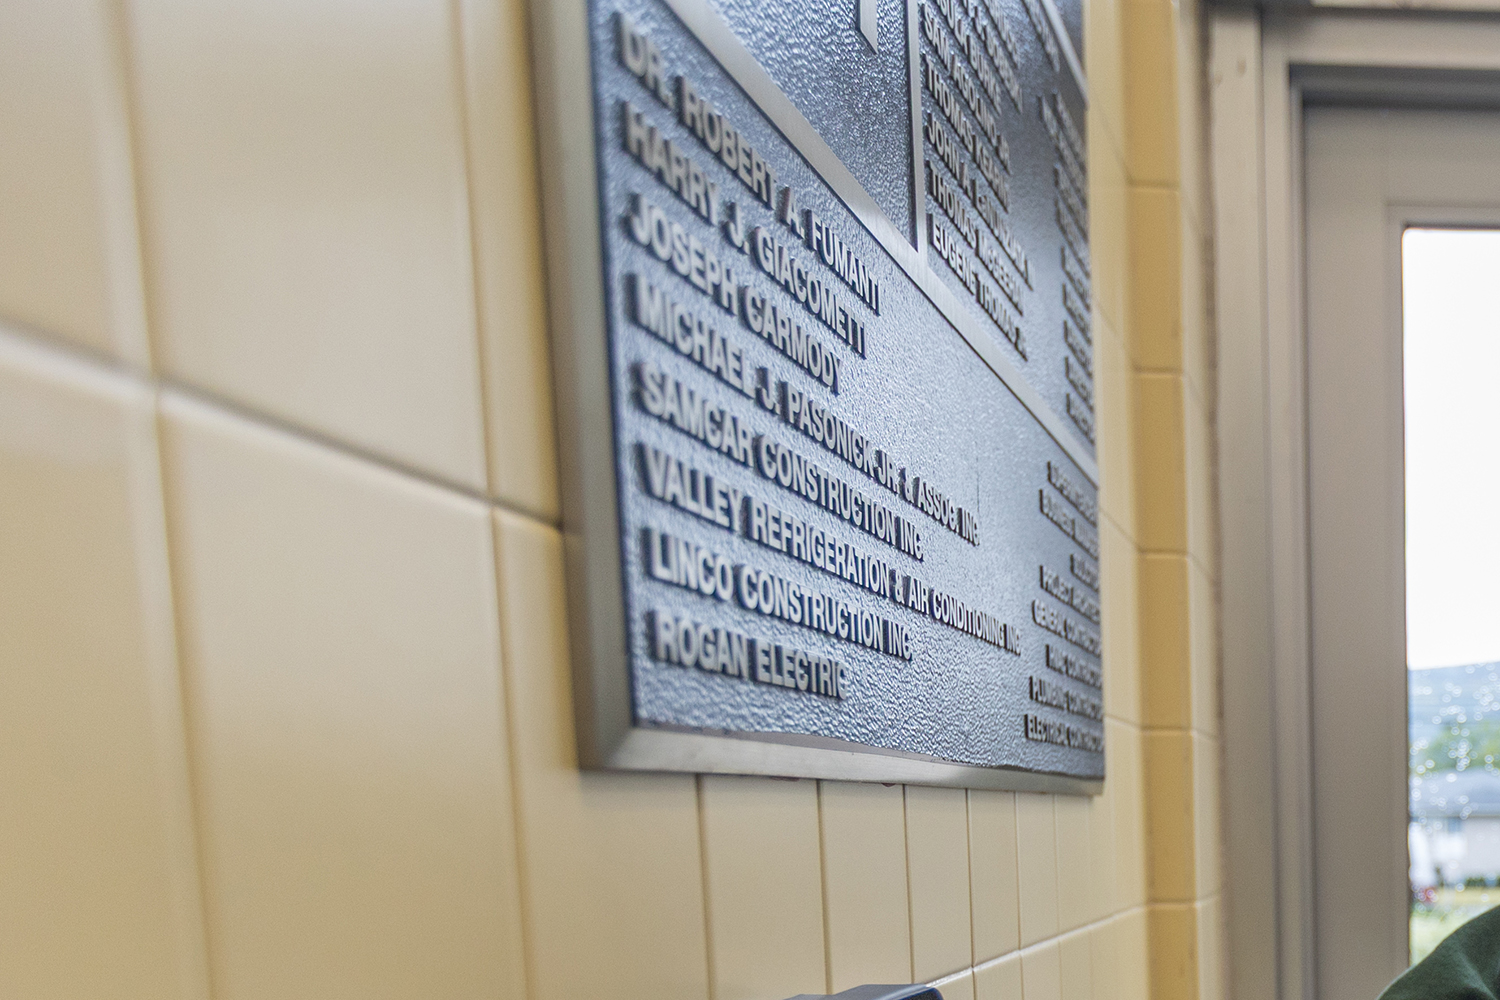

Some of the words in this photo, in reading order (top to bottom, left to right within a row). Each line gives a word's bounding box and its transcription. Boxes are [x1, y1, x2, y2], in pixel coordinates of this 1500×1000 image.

[923, 3, 950, 72] SAM
[617, 10, 674, 110] DR.
[680, 75, 778, 211] ROBERT
[784, 186, 805, 239] A.
[926, 55, 973, 153] THOMAS
[927, 116, 961, 182] JOHN
[623, 102, 719, 227] HARRY
[725, 202, 750, 256] J.
[930, 161, 977, 250] THOMAS
[630, 195, 739, 317] JOSEPH
[743, 285, 842, 396] CARMODY
[932, 216, 974, 296] EUGENE
[636, 274, 758, 401] MICHAEL
[760, 368, 781, 415] J.
[786, 381, 875, 480] PASONICK
[641, 362, 754, 468] SAMCAR
[760, 434, 896, 547] CONSTRUCTION
[645, 445, 744, 534] VALLEY
[750, 497, 890, 599] REFRIGERATION
[893, 570, 906, 604] &
[908, 575, 930, 615] AIR
[931, 588, 1005, 648] CONDITIONING
[650, 528, 735, 601] LINCO
[739, 563, 884, 652] CONSTRUCTION
[654, 612, 751, 681] ROGAN
[755, 638, 848, 700] ELECTRIC
